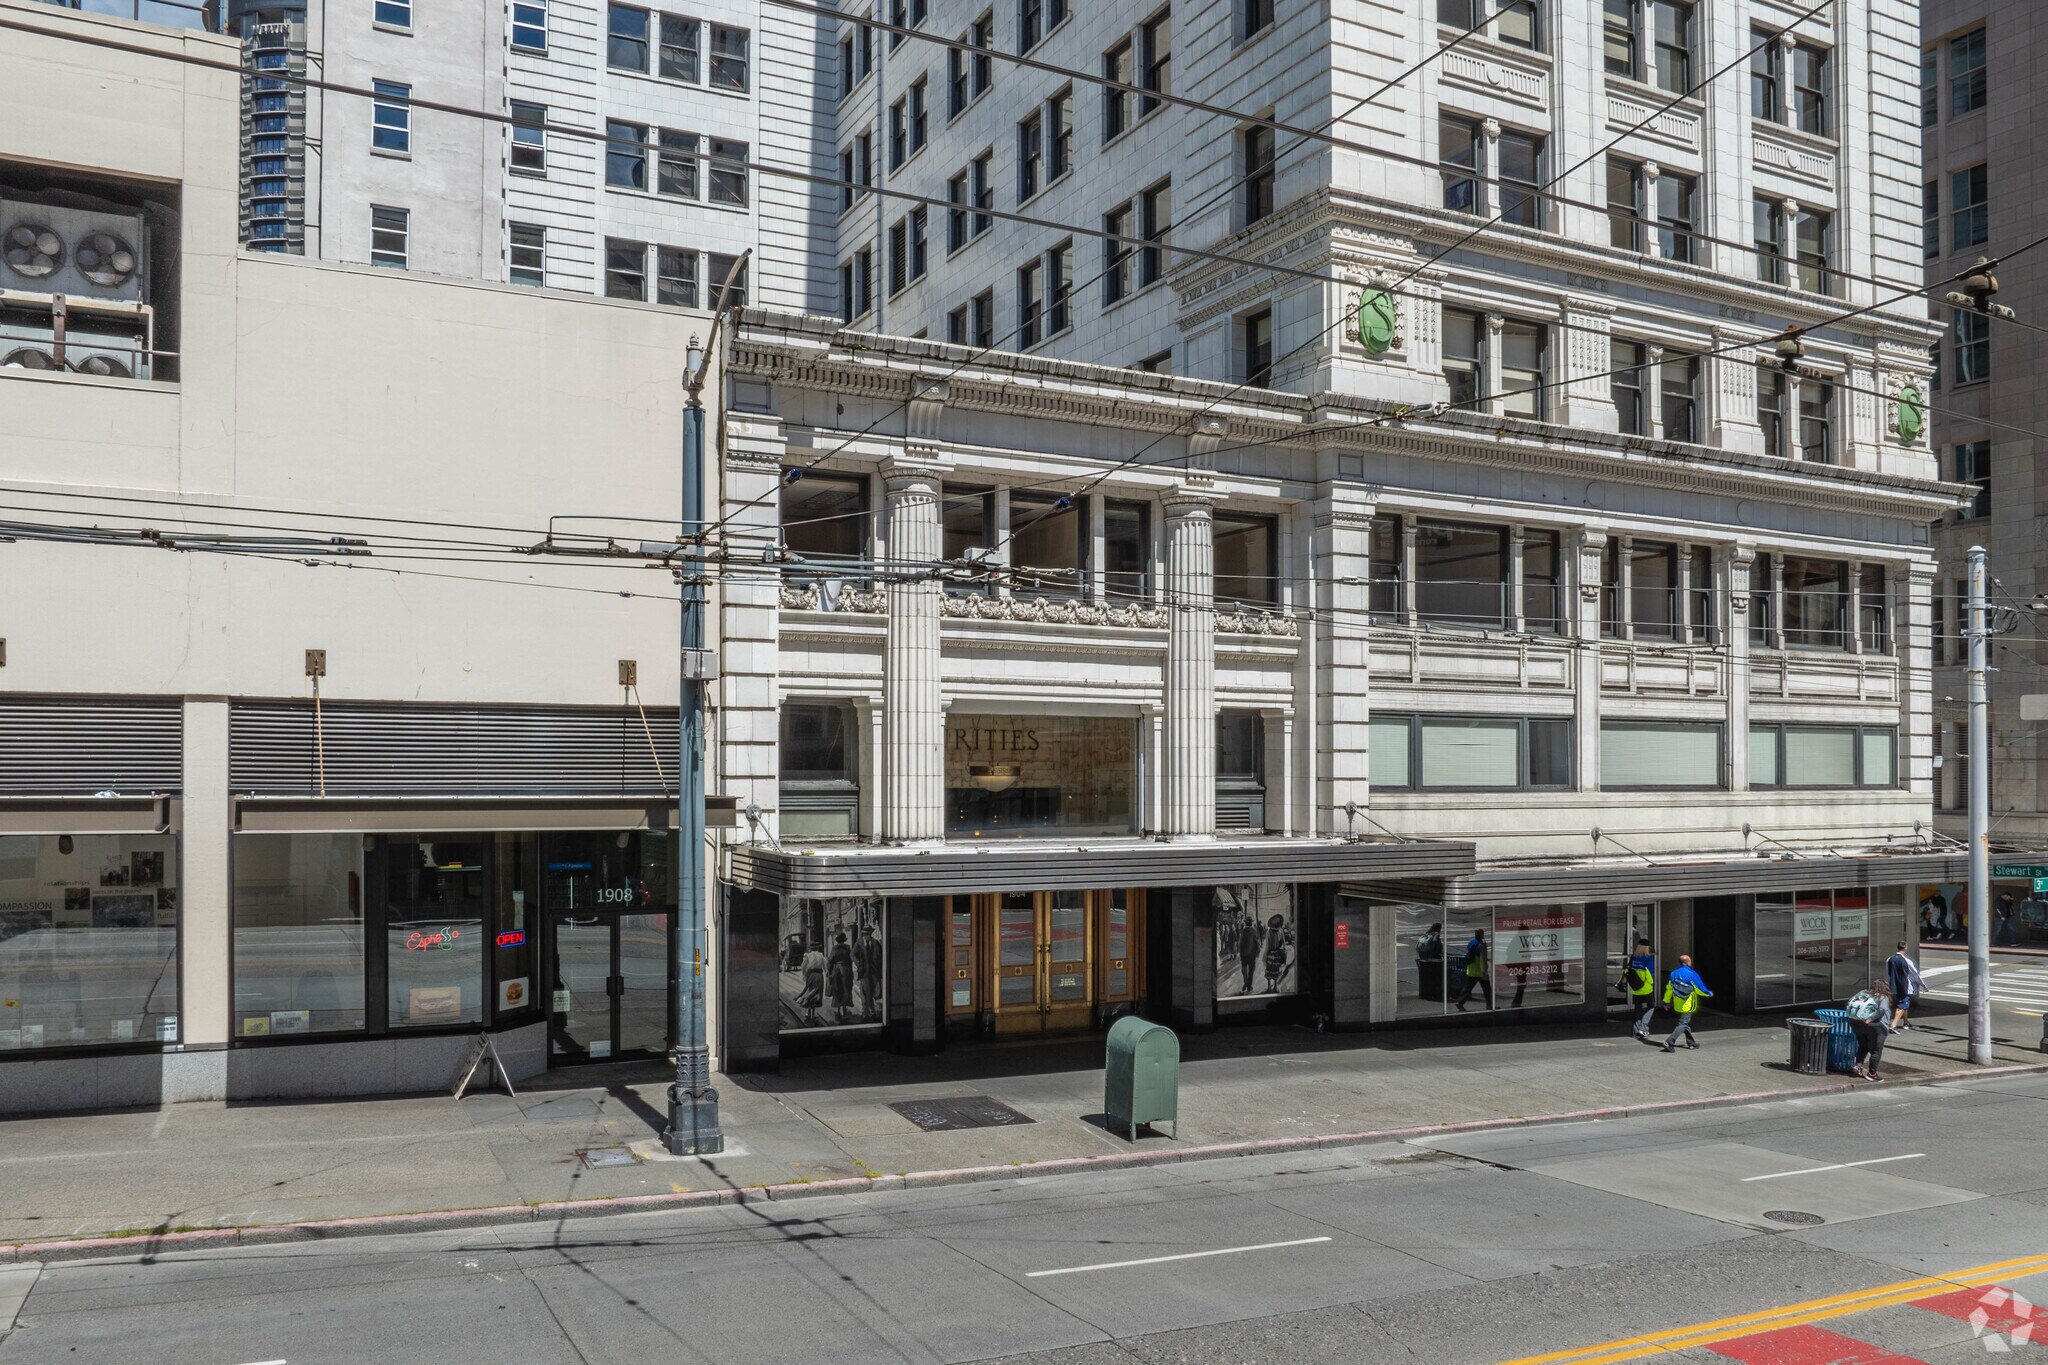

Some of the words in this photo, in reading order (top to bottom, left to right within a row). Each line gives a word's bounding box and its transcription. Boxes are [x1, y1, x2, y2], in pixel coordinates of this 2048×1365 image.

[945, 728, 1039, 751] RITIES
[1995, 865, 2031, 876] Stewart
[597, 888, 633, 903] 1908
[1502, 920, 1522, 928] PRIME
[1522, 919, 1543, 927] RETAIL
[1543, 918, 1556, 926] FOR
[1557, 917, 1575, 925] LEASE
[1800, 916, 1827, 929] WCCR
[406, 926, 460, 952] Espresso
[496, 933, 523, 947] OPEN
[1518, 933, 1560, 949] WCCR
[1508, 964, 1558, 977] 206-283-5212
